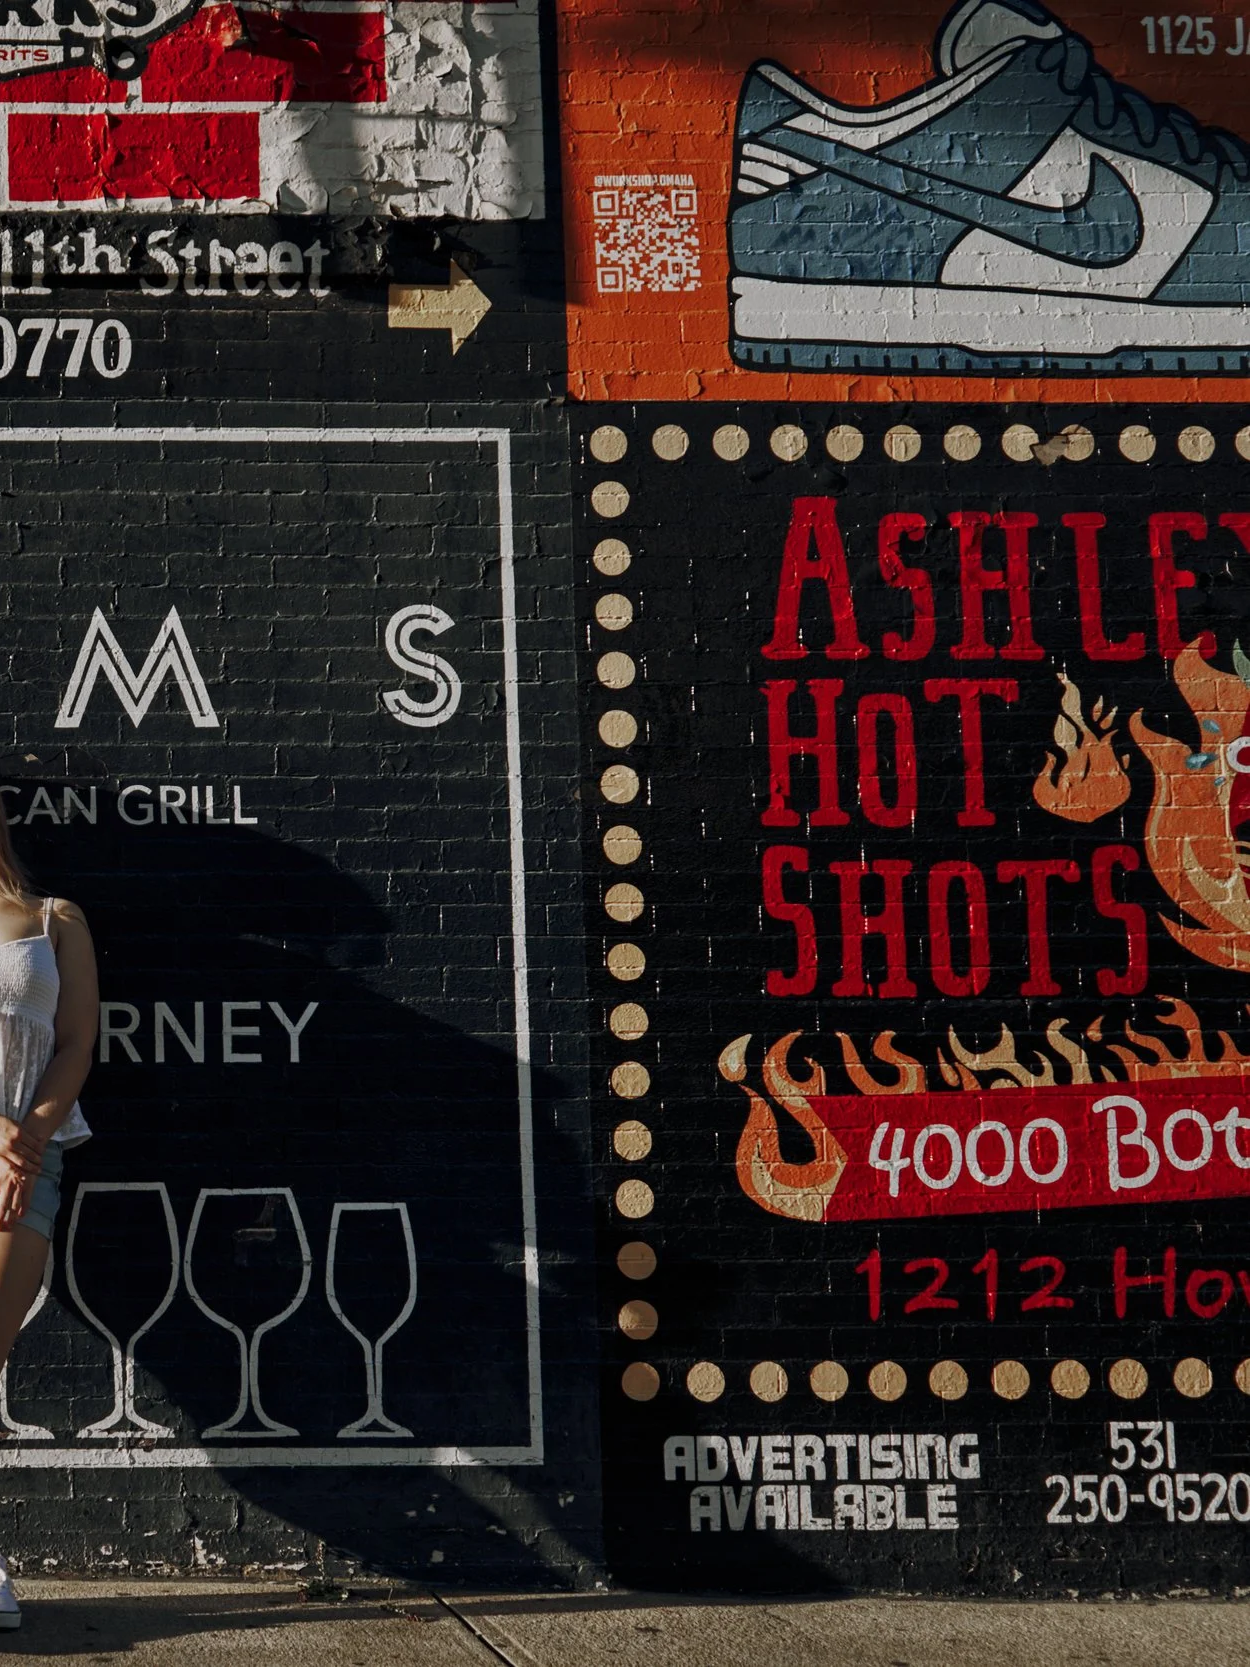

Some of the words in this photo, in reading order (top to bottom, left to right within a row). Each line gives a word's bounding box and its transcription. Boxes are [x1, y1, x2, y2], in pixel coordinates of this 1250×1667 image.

[1140, 15, 1216, 55] 1125
[140, 226, 331, 297] Street
[760, 678, 1019, 828] HOT
[117, 784, 259, 826] GRILL
[762, 844, 1149, 998] SHOTS
[868, 1117, 1068, 1198] 4000
[855, 1248, 1075, 1322] 1212
[1113, 1246, 1250, 1320] Ho
[662, 1433, 981, 1482] ADVERTISING
[1108, 1421, 1177, 1471] 531
[689, 1484, 960, 1532] AVAILABLE
[1045, 1472, 1250, 1524] 250-9520
